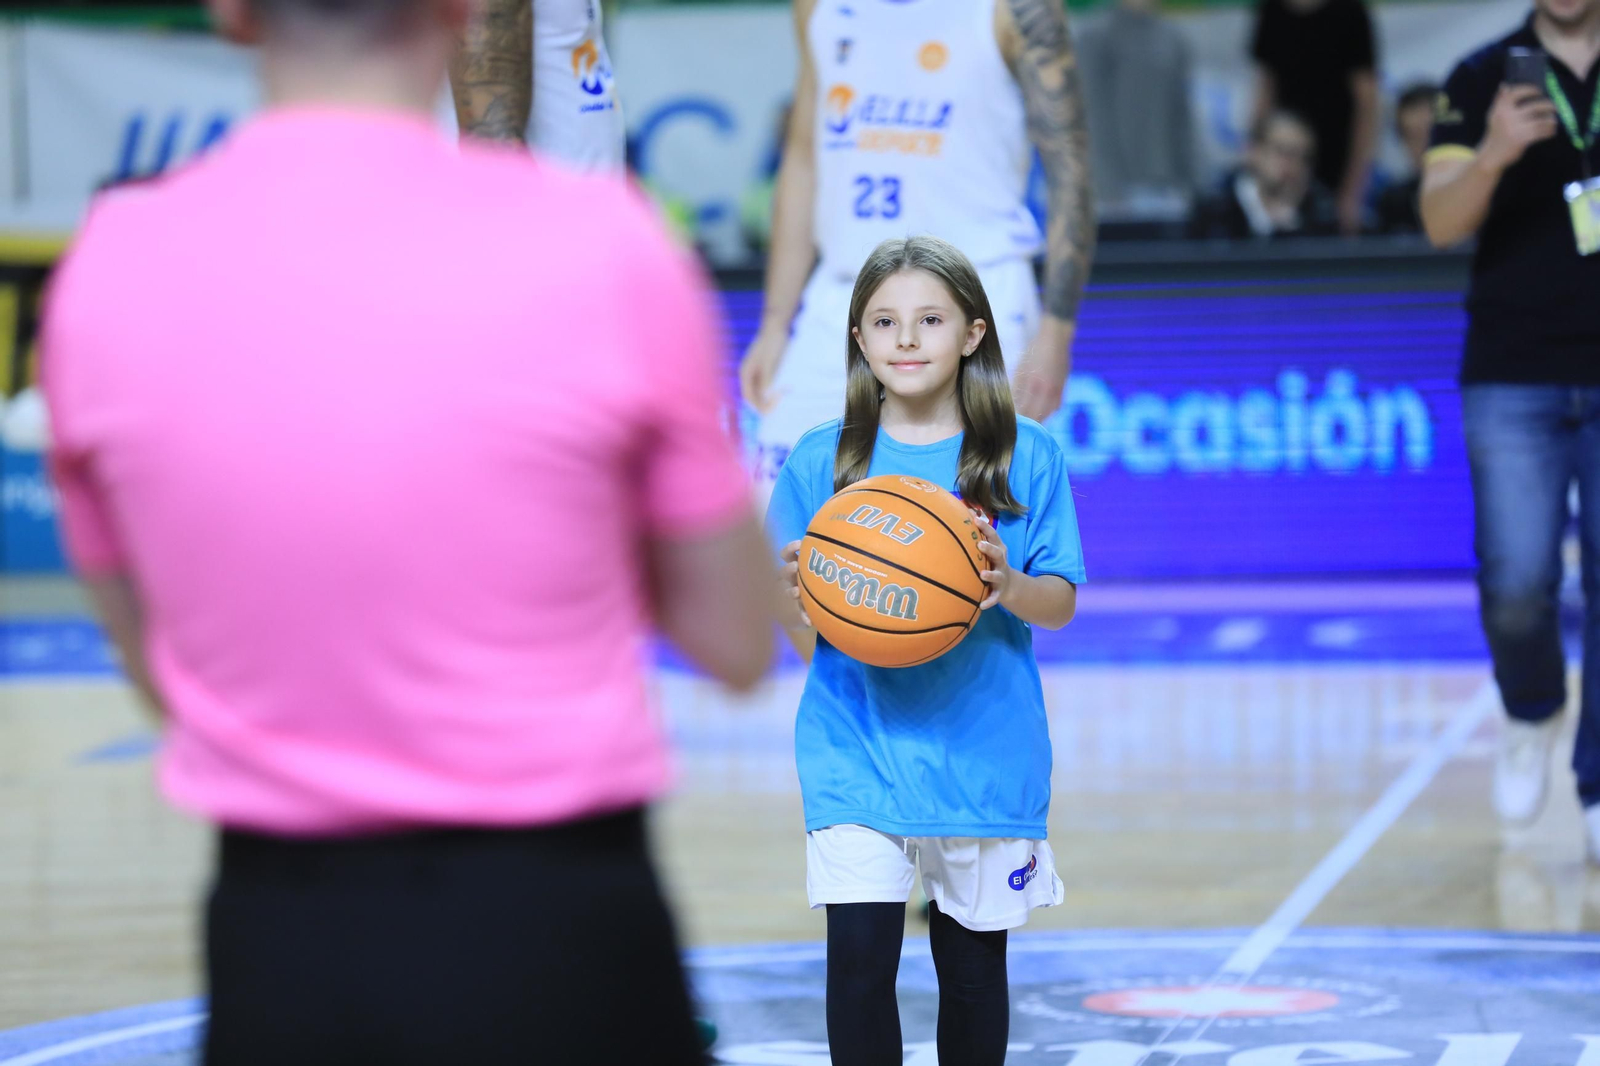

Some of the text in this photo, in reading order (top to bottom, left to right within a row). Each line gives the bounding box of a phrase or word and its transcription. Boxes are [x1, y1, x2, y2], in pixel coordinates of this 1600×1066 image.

[853, 175, 902, 219] 23
[1060, 368, 1434, 476] Ocasión
[846, 504, 925, 546] EVO
[807, 547, 919, 621] Wilson
